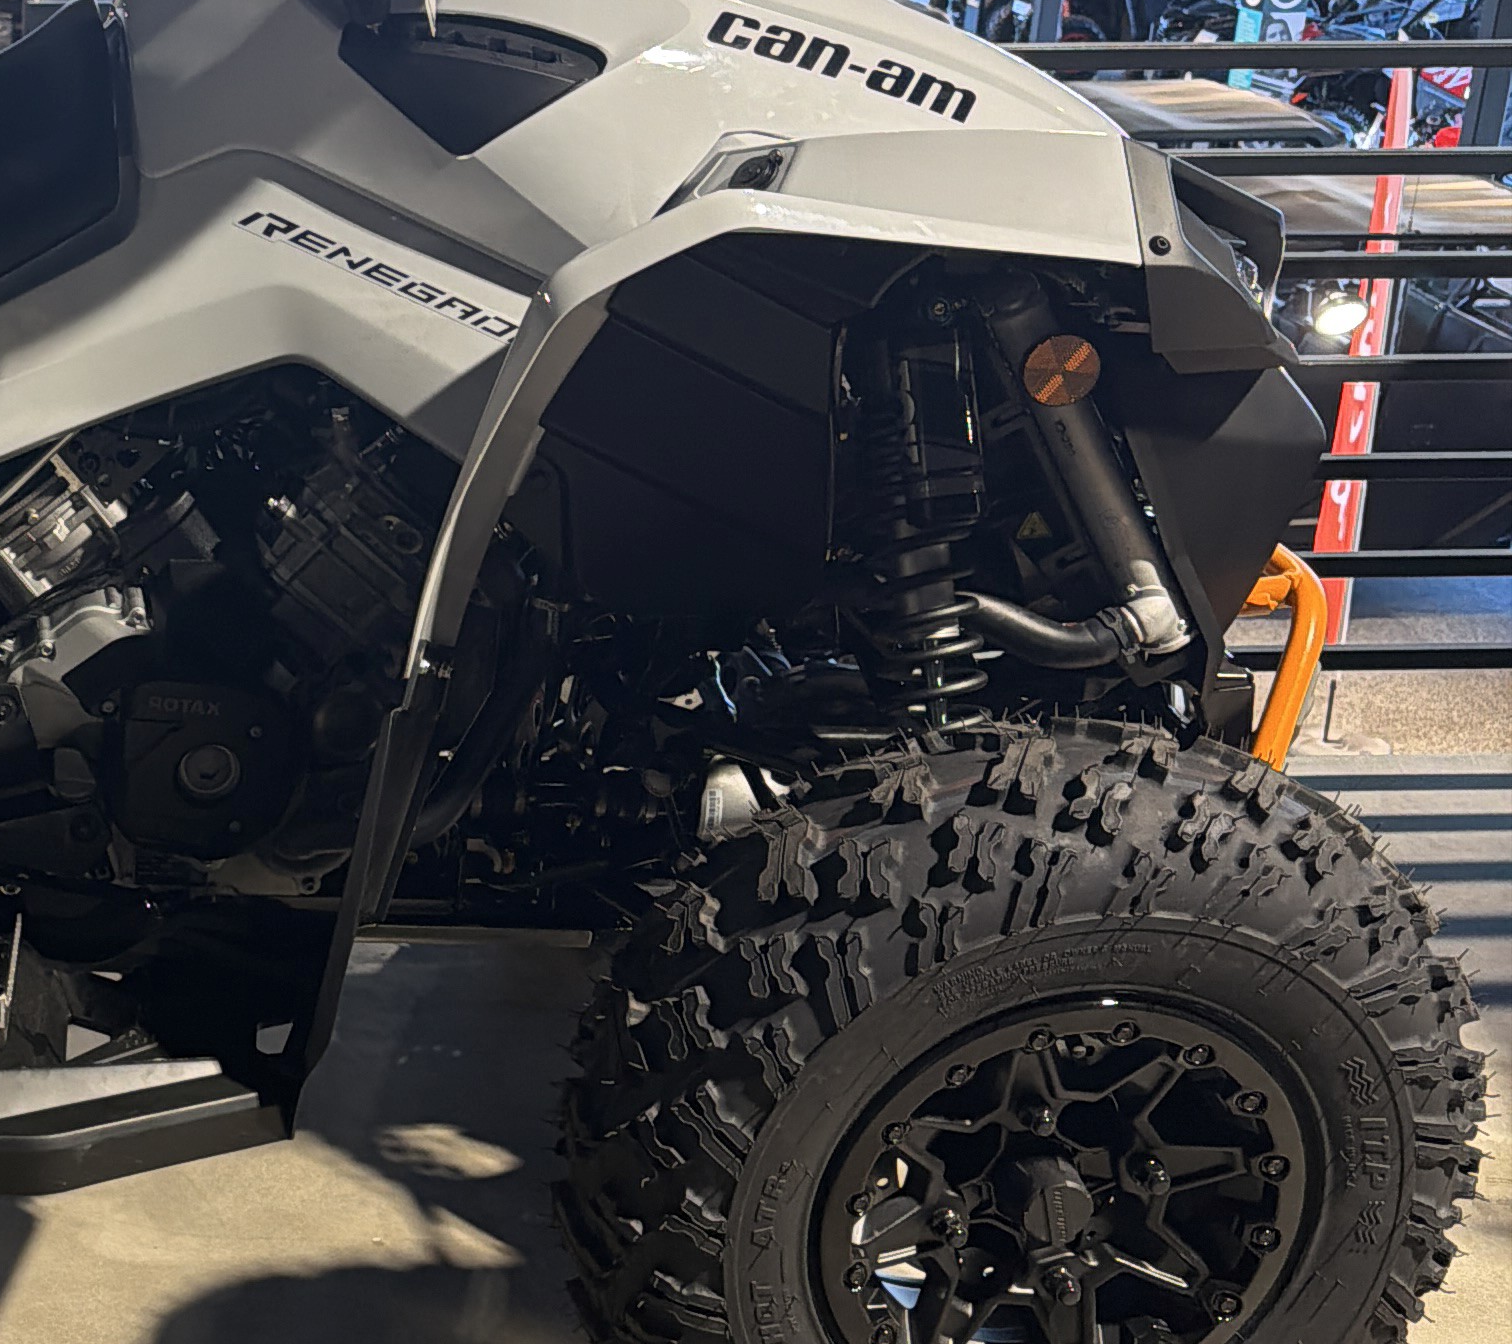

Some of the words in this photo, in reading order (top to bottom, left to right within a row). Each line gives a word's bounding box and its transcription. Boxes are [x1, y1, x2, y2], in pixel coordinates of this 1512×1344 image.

[706, 11, 977, 124] can-am
[238, 212, 518, 342] RENEGAD
[148, 696, 222, 716] ROTAX
[1359, 1117, 1391, 1190] ITP
